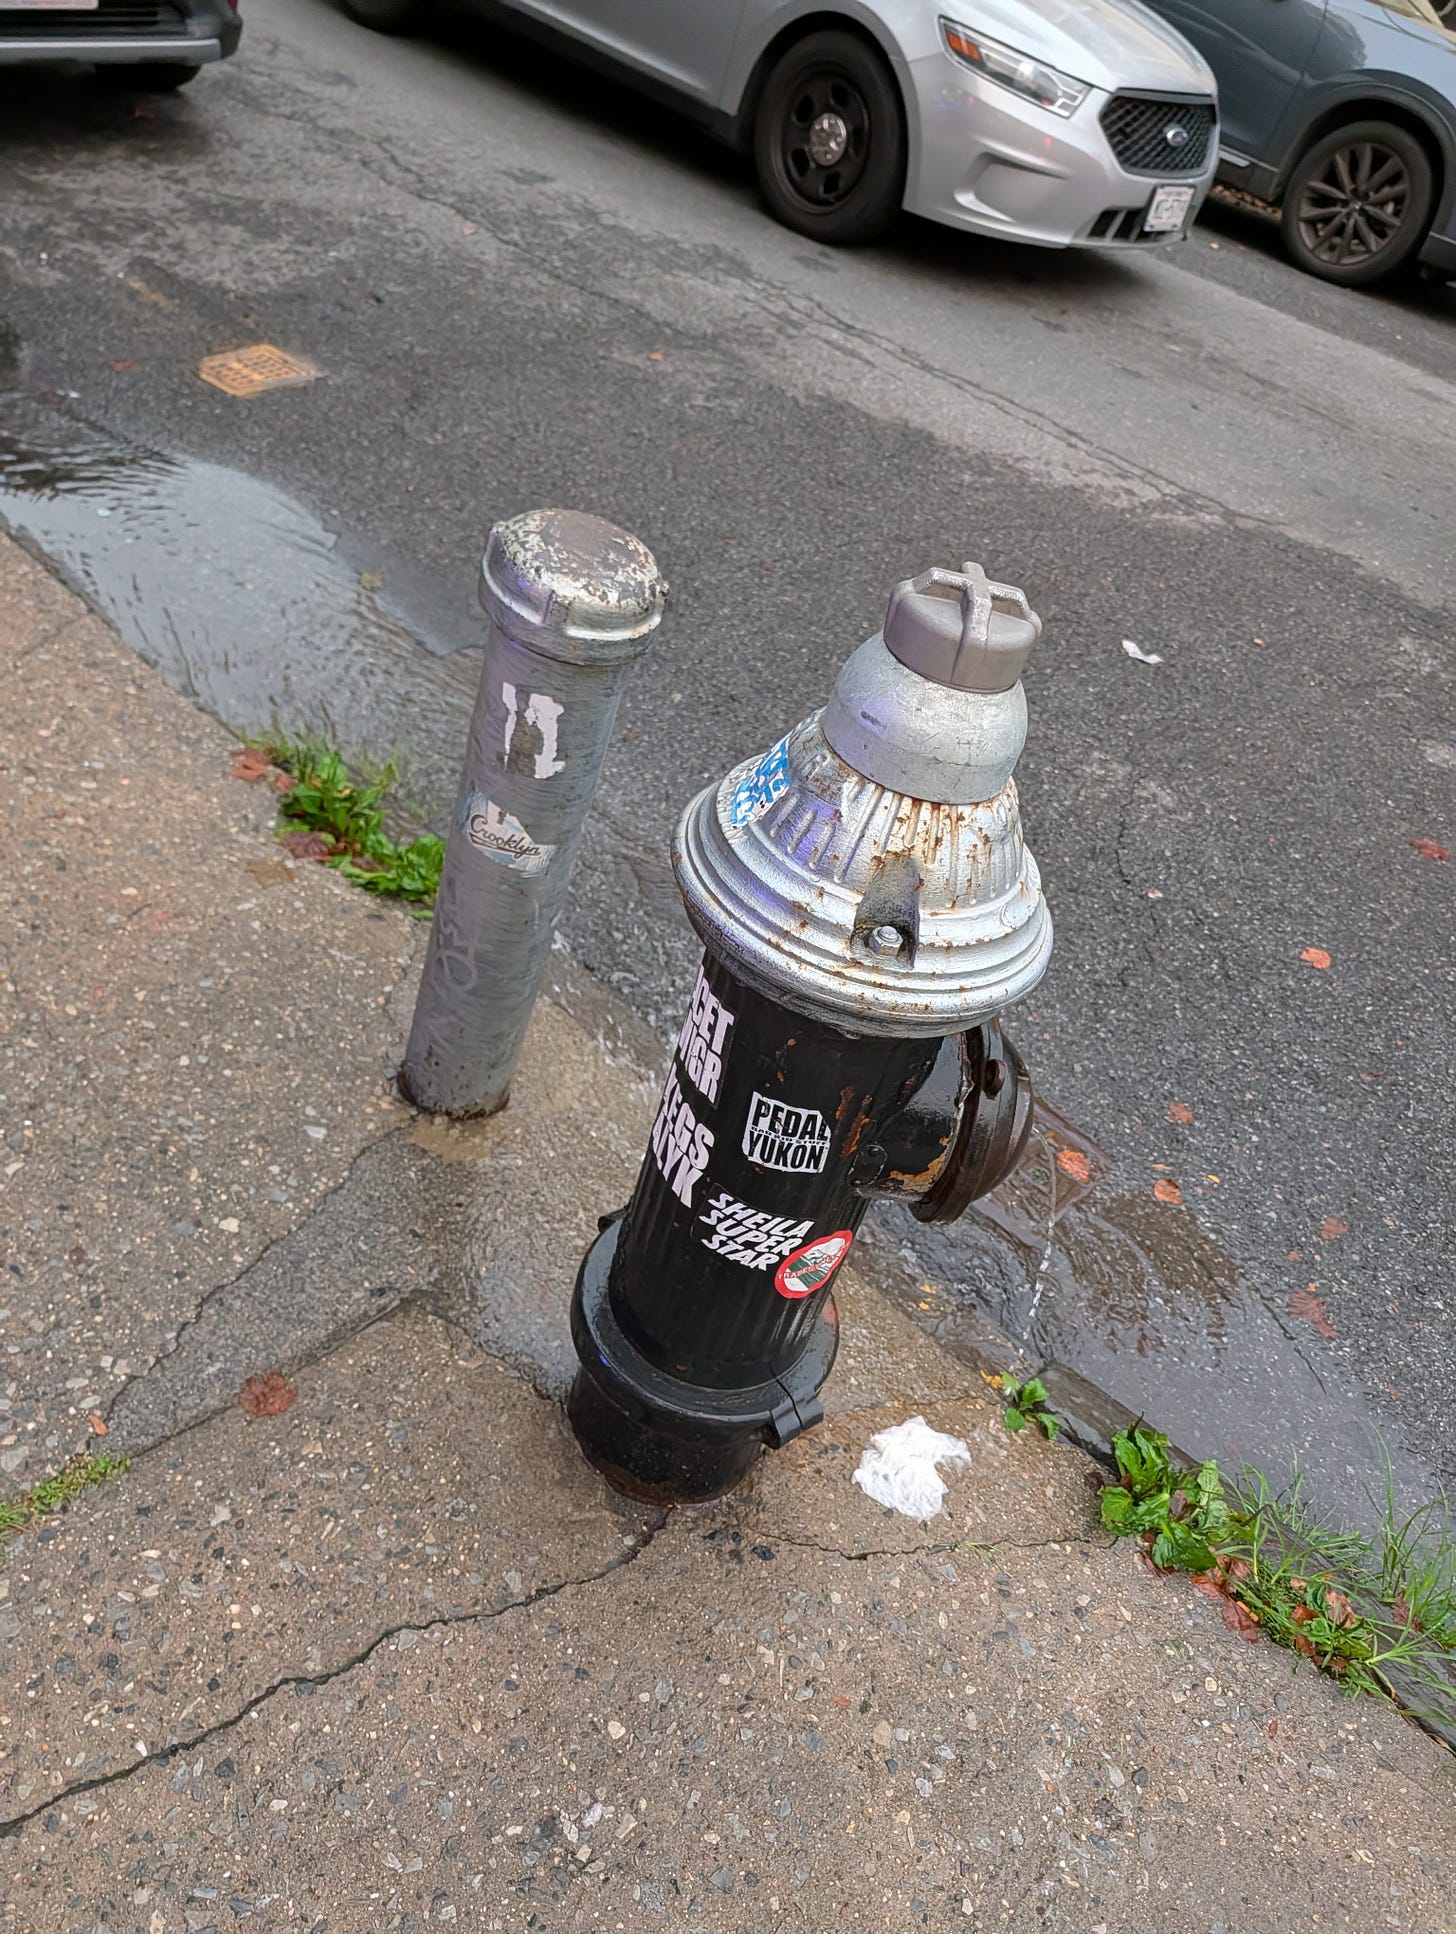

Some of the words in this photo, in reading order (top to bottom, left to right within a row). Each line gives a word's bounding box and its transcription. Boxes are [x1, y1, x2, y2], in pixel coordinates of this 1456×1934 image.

[469, 814, 541, 859] Crooklyn
[752, 1099, 829, 1141] PEDAL
[748, 1130, 826, 1170] YUKON
[698, 1209, 803, 1256] SUPER
[708, 1193, 815, 1238] SHEILA
[701, 1234, 780, 1271] STAR
